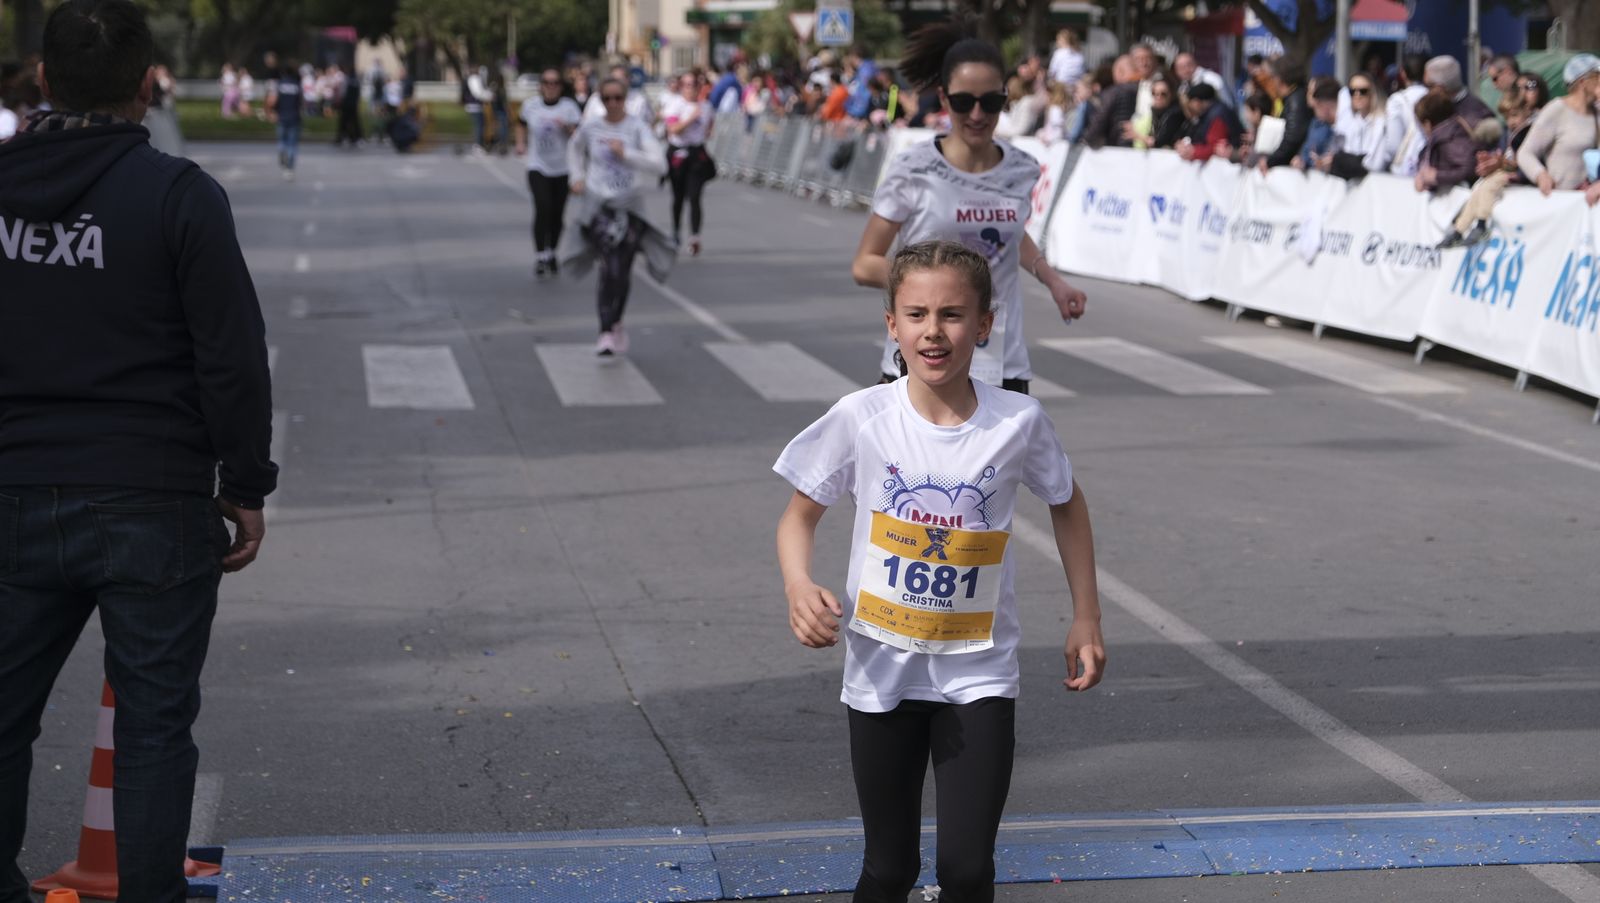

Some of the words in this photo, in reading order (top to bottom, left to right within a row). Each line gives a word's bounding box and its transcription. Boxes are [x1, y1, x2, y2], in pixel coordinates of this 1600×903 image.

[956, 209, 1018, 223] MUJER
[911, 509, 963, 528] MINI
[886, 530, 918, 547] MUJER
[883, 555, 980, 599] 1681
[901, 593, 954, 609] CRISTINA
